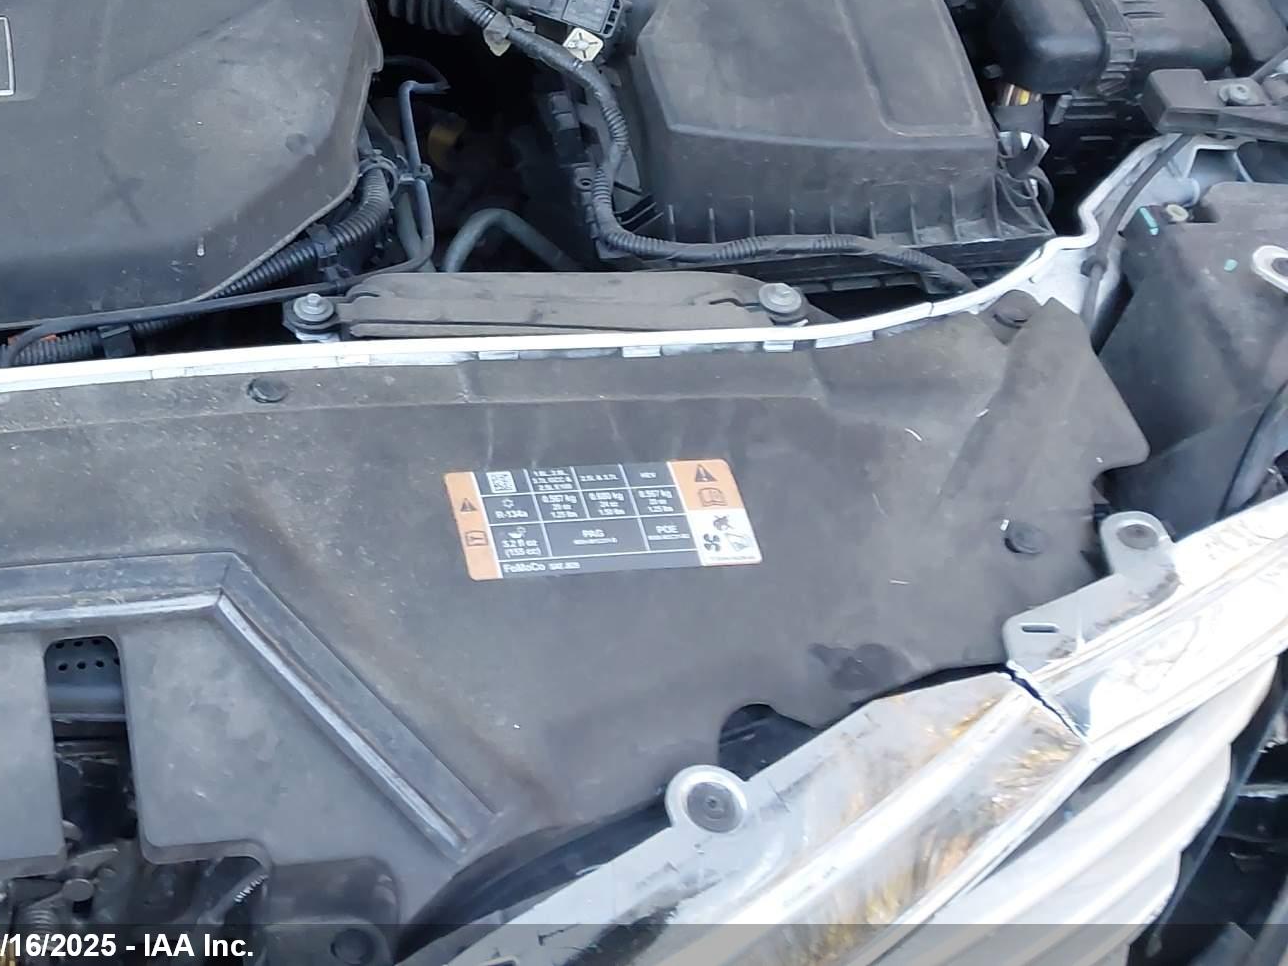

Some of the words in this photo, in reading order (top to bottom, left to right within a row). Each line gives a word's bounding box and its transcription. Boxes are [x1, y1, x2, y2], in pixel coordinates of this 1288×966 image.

[494, 509, 529, 519] R-134a
[581, 528, 605, 539] PAG
[502, 561, 546, 573] FoMoCo
